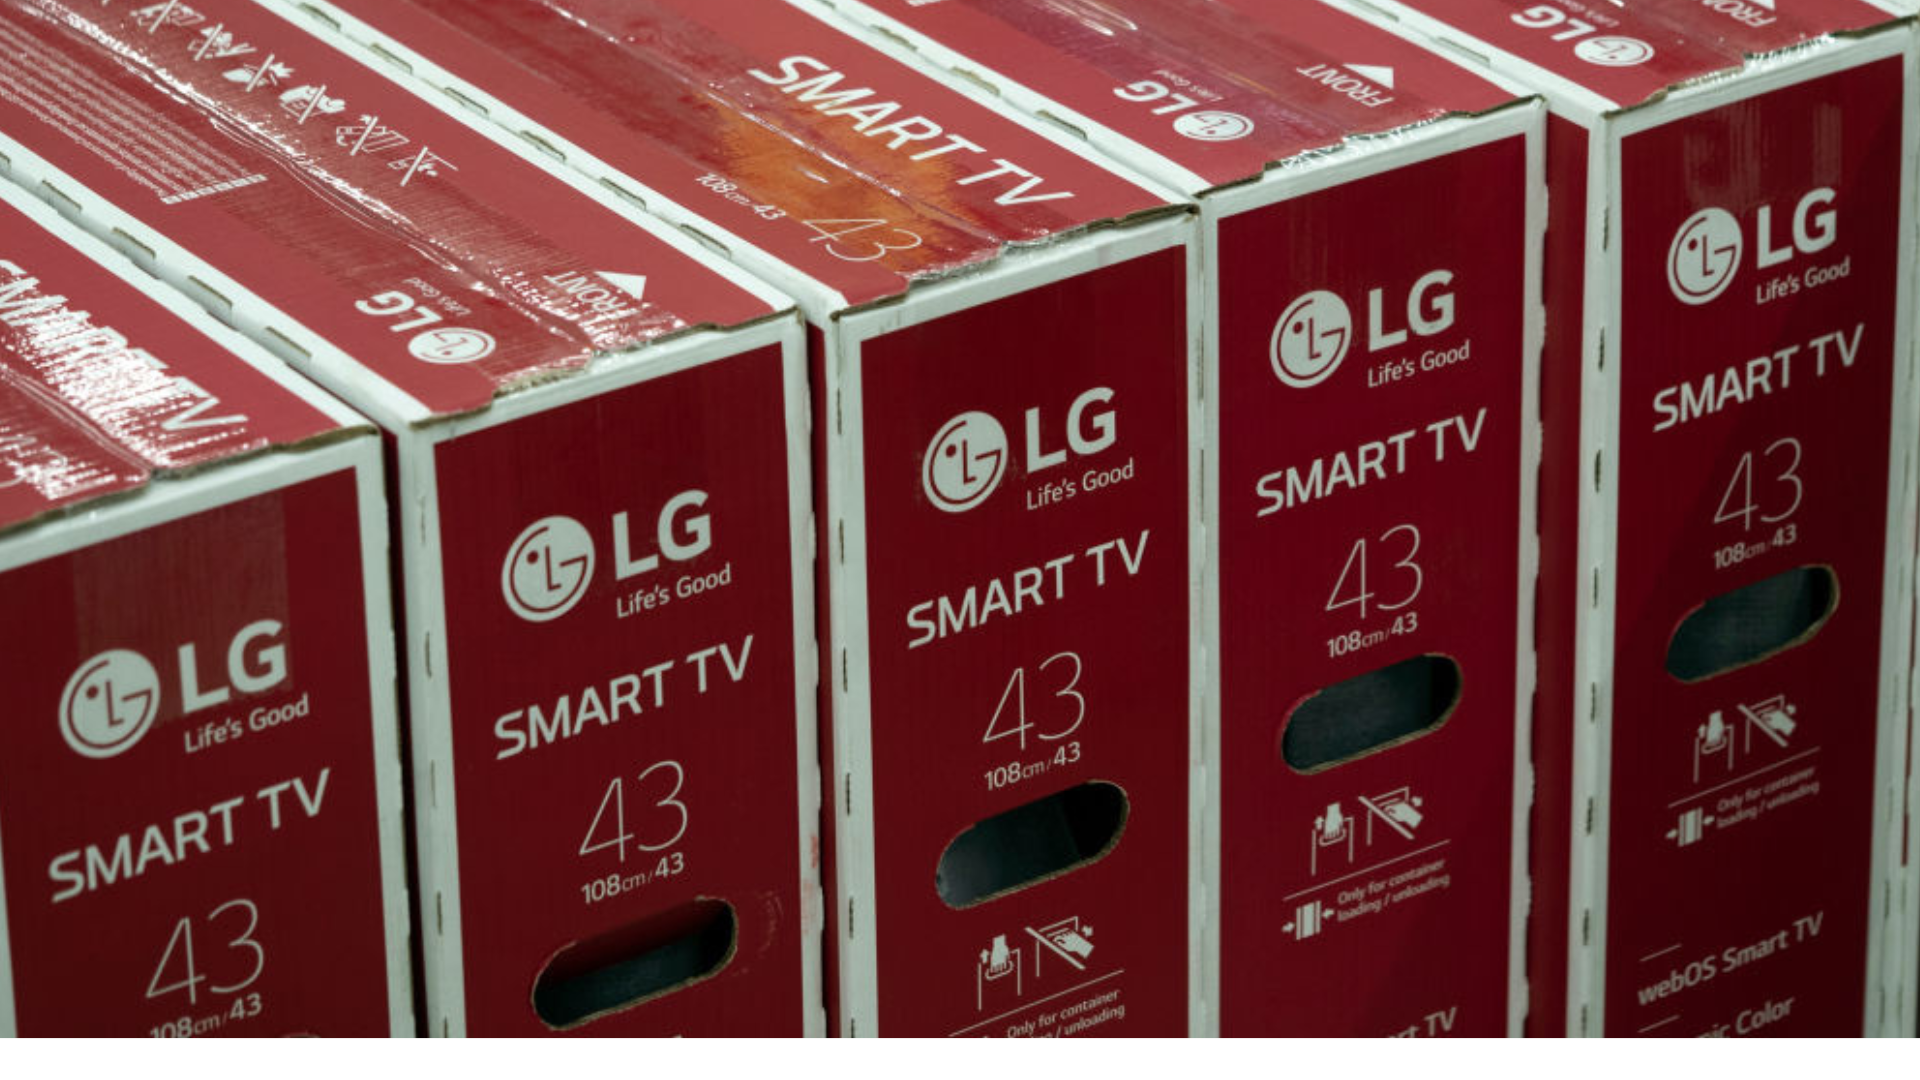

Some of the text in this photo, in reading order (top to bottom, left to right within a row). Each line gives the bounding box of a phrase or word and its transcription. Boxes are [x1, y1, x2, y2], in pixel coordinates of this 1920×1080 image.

[1510, 5, 1597, 41] LG
[1703, 0, 1777, 28] FRO
[1112, 80, 1199, 115] LG
[1295, 63, 1394, 108] FRONT
[747, 55, 1075, 206] SMART TV
[802, 218, 922, 262] 43
[1757, 187, 1837, 269] LG
[355, 291, 443, 332] LG
[1368, 269, 1455, 353] LG
[1756, 255, 1851, 305] Life's Good
[1368, 338, 1471, 388] Life's Good
[1652, 323, 1865, 432] SMART TV
[1025, 386, 1117, 474] LG
[1256, 407, 1487, 518] SMART TV
[1026, 457, 1135, 510] Life's Good
[1713, 437, 1802, 531] 43
[612, 489, 712, 580] LG
[1325, 524, 1423, 620] 43
[616, 562, 732, 618] Life's Good
[906, 529, 1150, 649] SMART TV
[178, 619, 287, 713] LG
[494, 634, 753, 760] SMART TV
[983, 651, 1085, 750] 43
[184, 692, 310, 753] Life's Good
[48, 767, 330, 902] SMART TV
[578, 760, 688, 863] 43
[146, 899, 264, 1004] 43
[1637, 911, 1824, 1006] webOS Smart TV
[1007, 989, 1121, 1037] Only for container
[1065, 1004, 1127, 1036] unloading
[1423, 1006, 1458, 1037] TV
[1735, 997, 1795, 1035] Color
